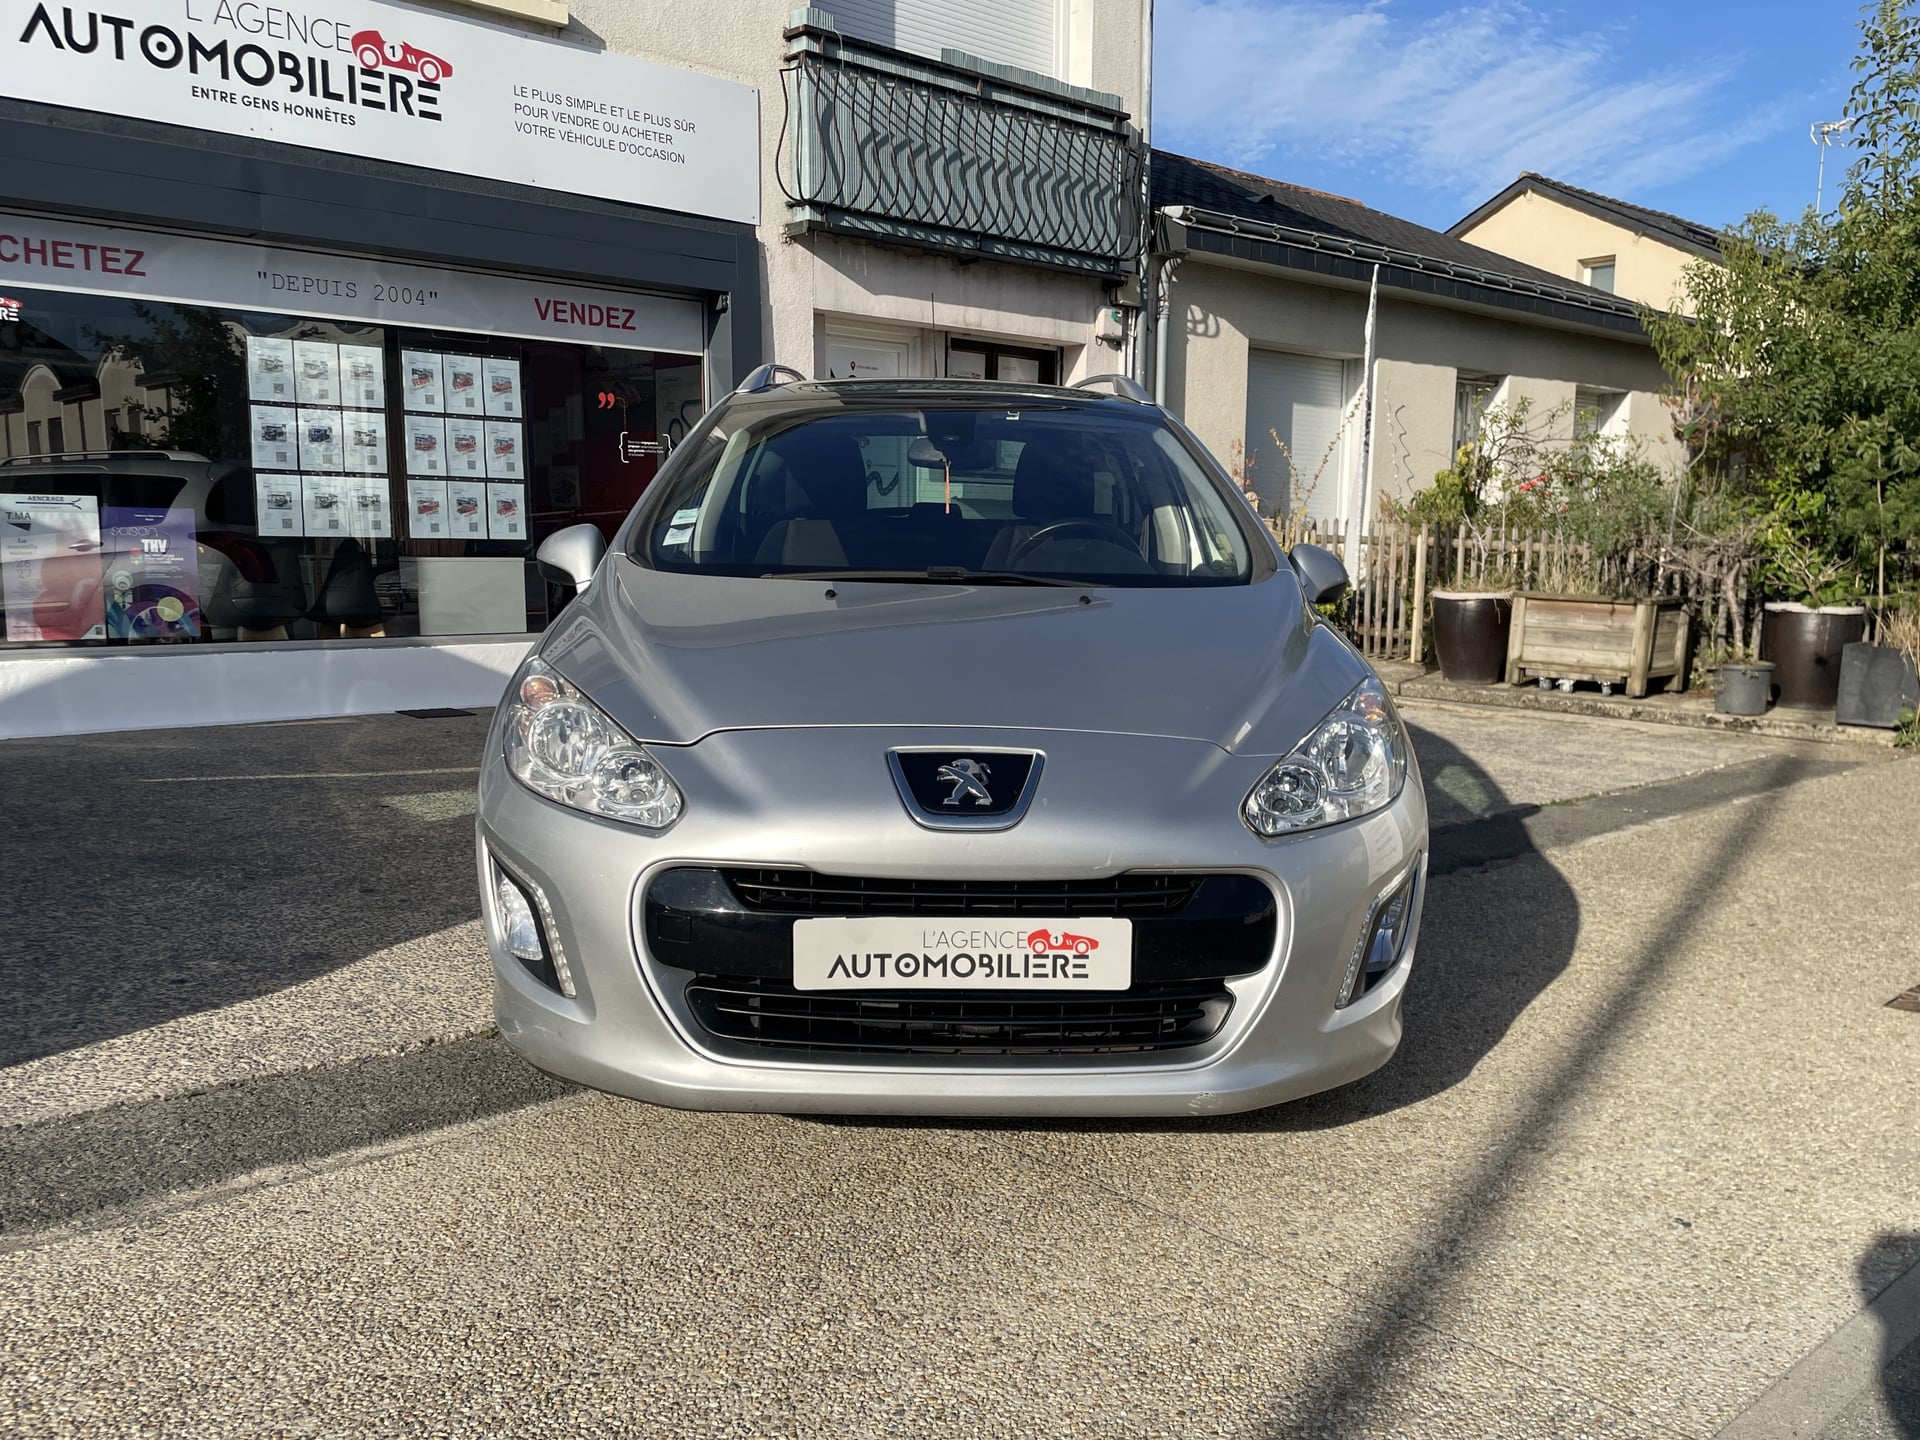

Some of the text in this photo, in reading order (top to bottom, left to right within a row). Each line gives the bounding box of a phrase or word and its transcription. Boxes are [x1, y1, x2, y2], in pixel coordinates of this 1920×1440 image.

[186, 0, 352, 53] LAGENCE
[191, 85, 356, 126] ENTRE GENS HONNÊTES
[514, 85, 696, 134] LE PLUS SIMPLE ET LE PLUS SÛR
[515, 103, 673, 145] POUR VENDRE OU ACHETER
[515, 121, 685, 164] VOTRE VÉHICULE D'OCCASION
[257, 271, 438, 306] "DEPUIS 2004"
[534, 298, 636, 331] VENDEZ
[923, 931, 1027, 949] L'AGENCE
[827, 954, 1089, 979] AUTOMOBILIERE
